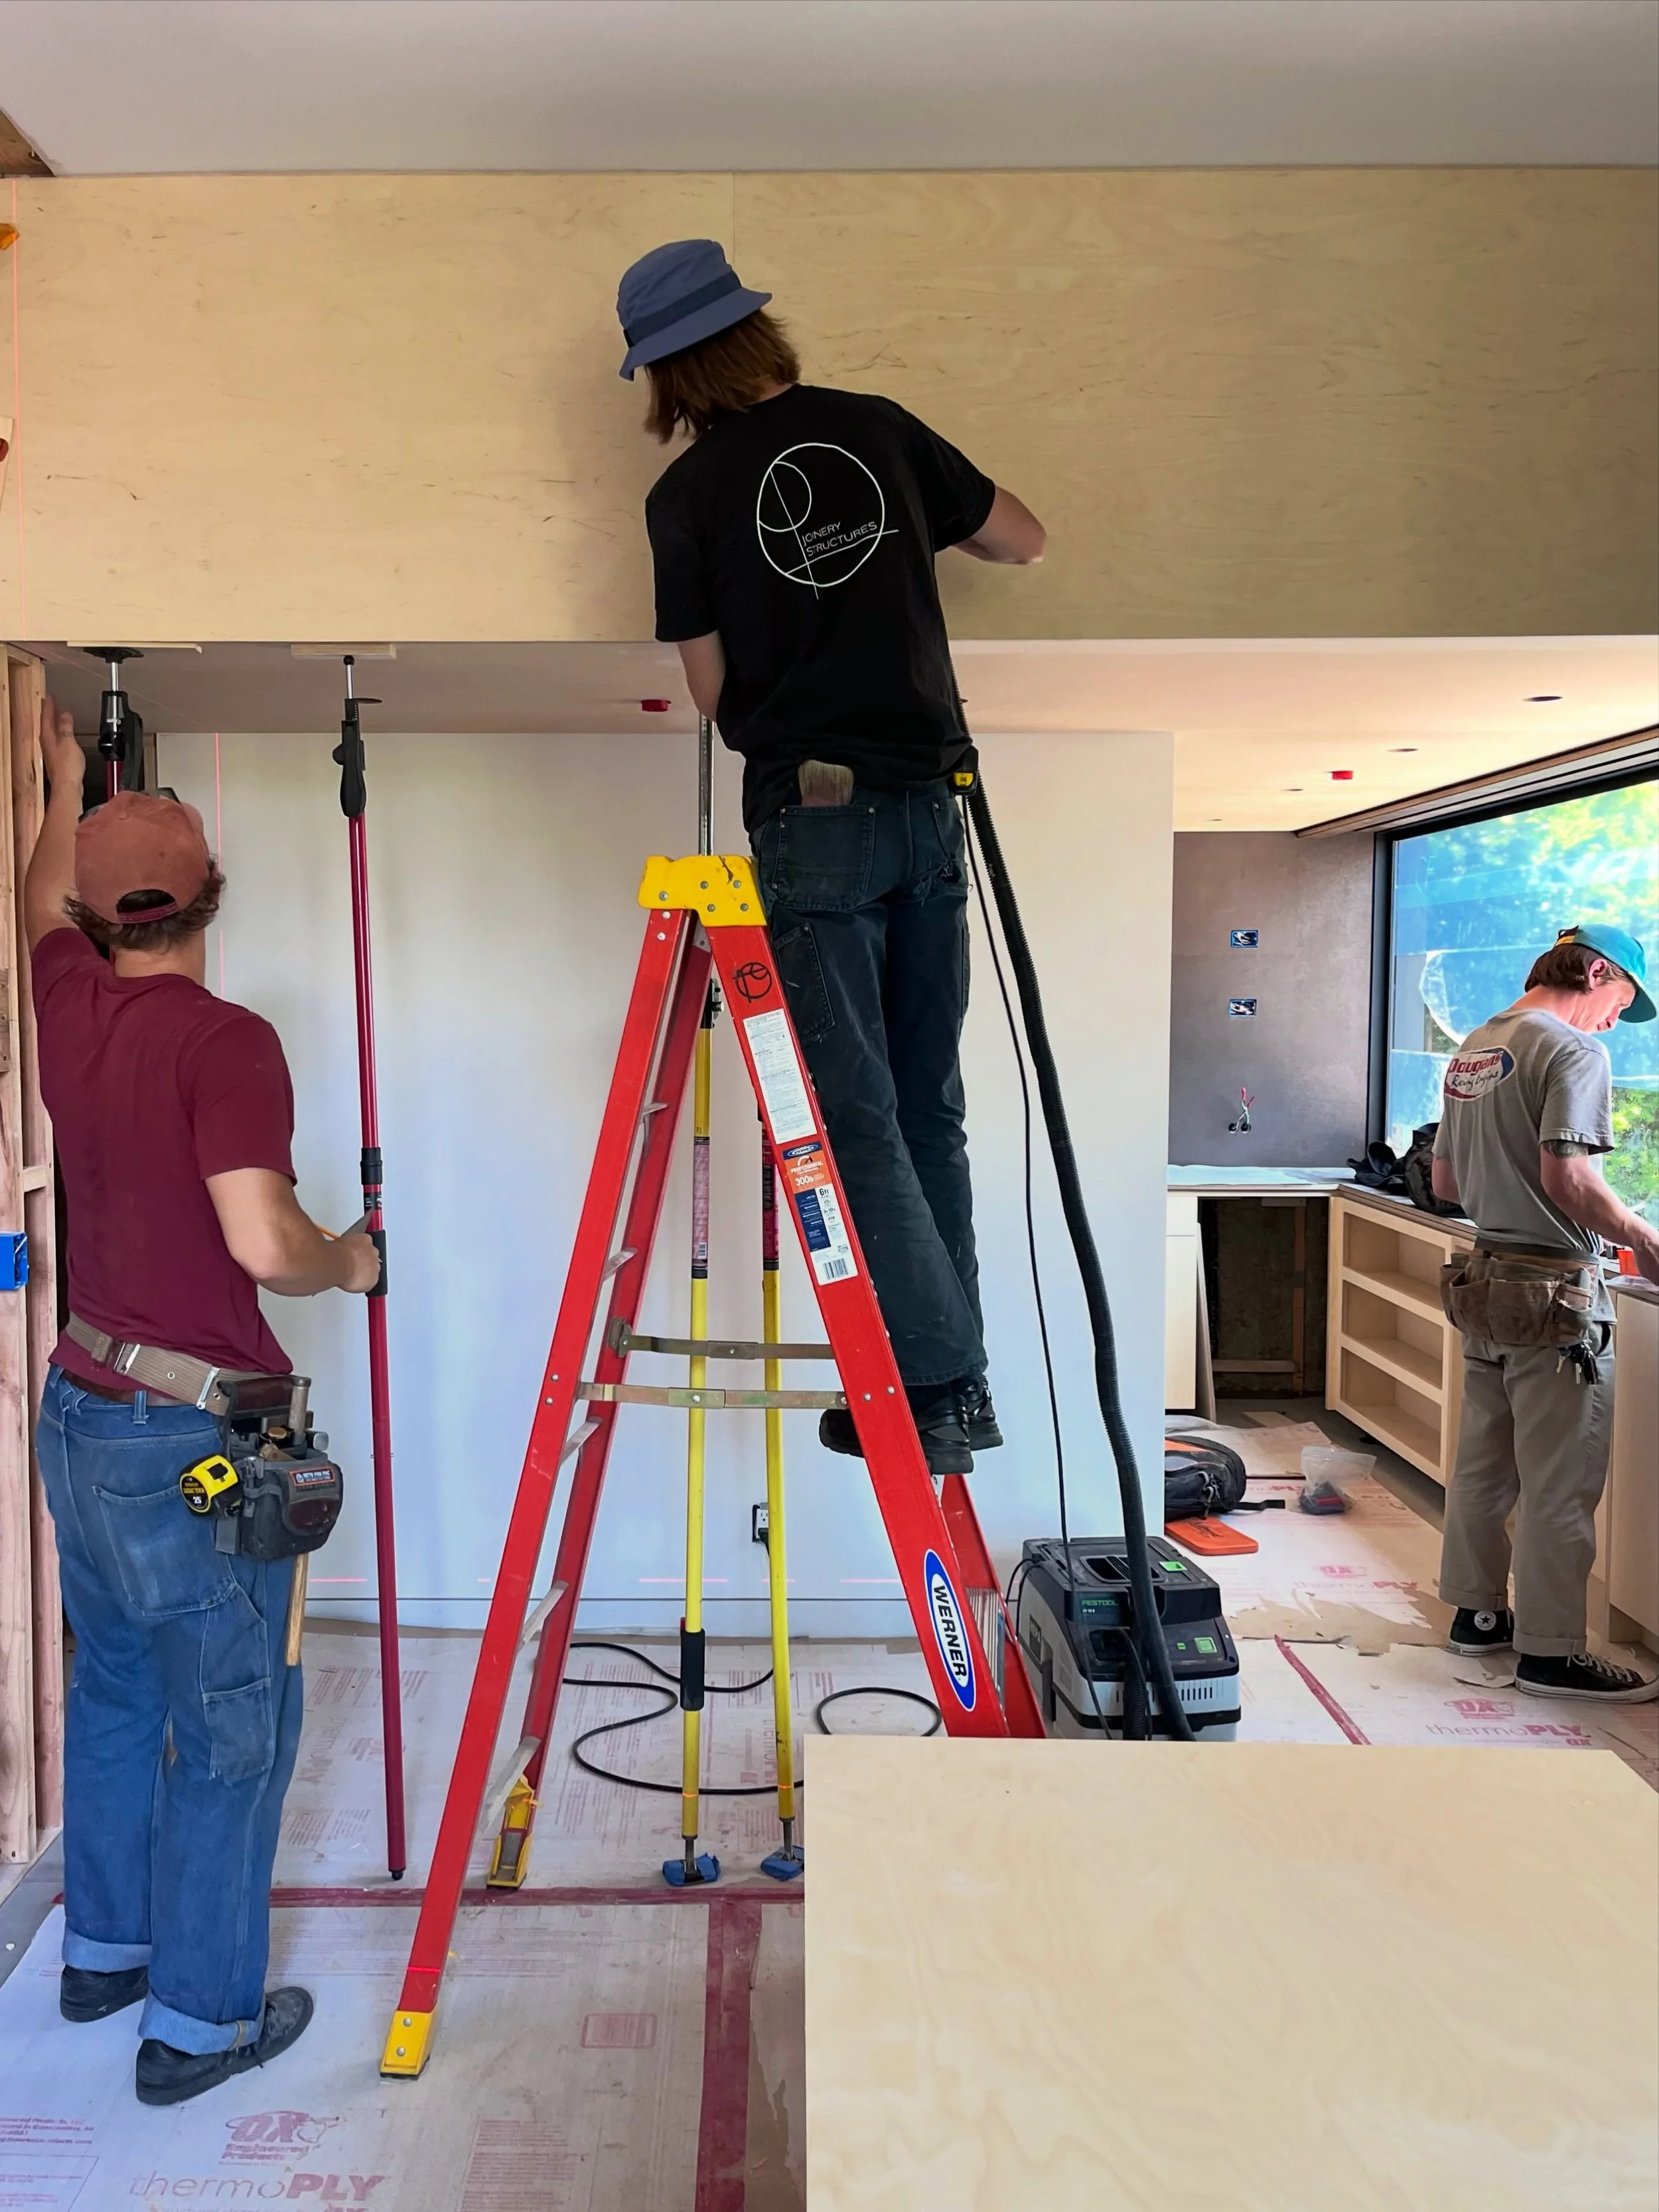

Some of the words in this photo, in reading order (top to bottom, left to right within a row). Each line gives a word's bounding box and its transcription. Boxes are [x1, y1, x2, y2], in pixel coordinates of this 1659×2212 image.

[802, 522, 841, 546] JOINERY
[806, 521, 877, 556] STRUCTURES
[934, 1585, 967, 1677] WERNER
[1454, 1700, 1498, 1712] OX
[1425, 1724, 1584, 1736] thermoPLY
[130, 2170, 385, 2201] thermoPLY
